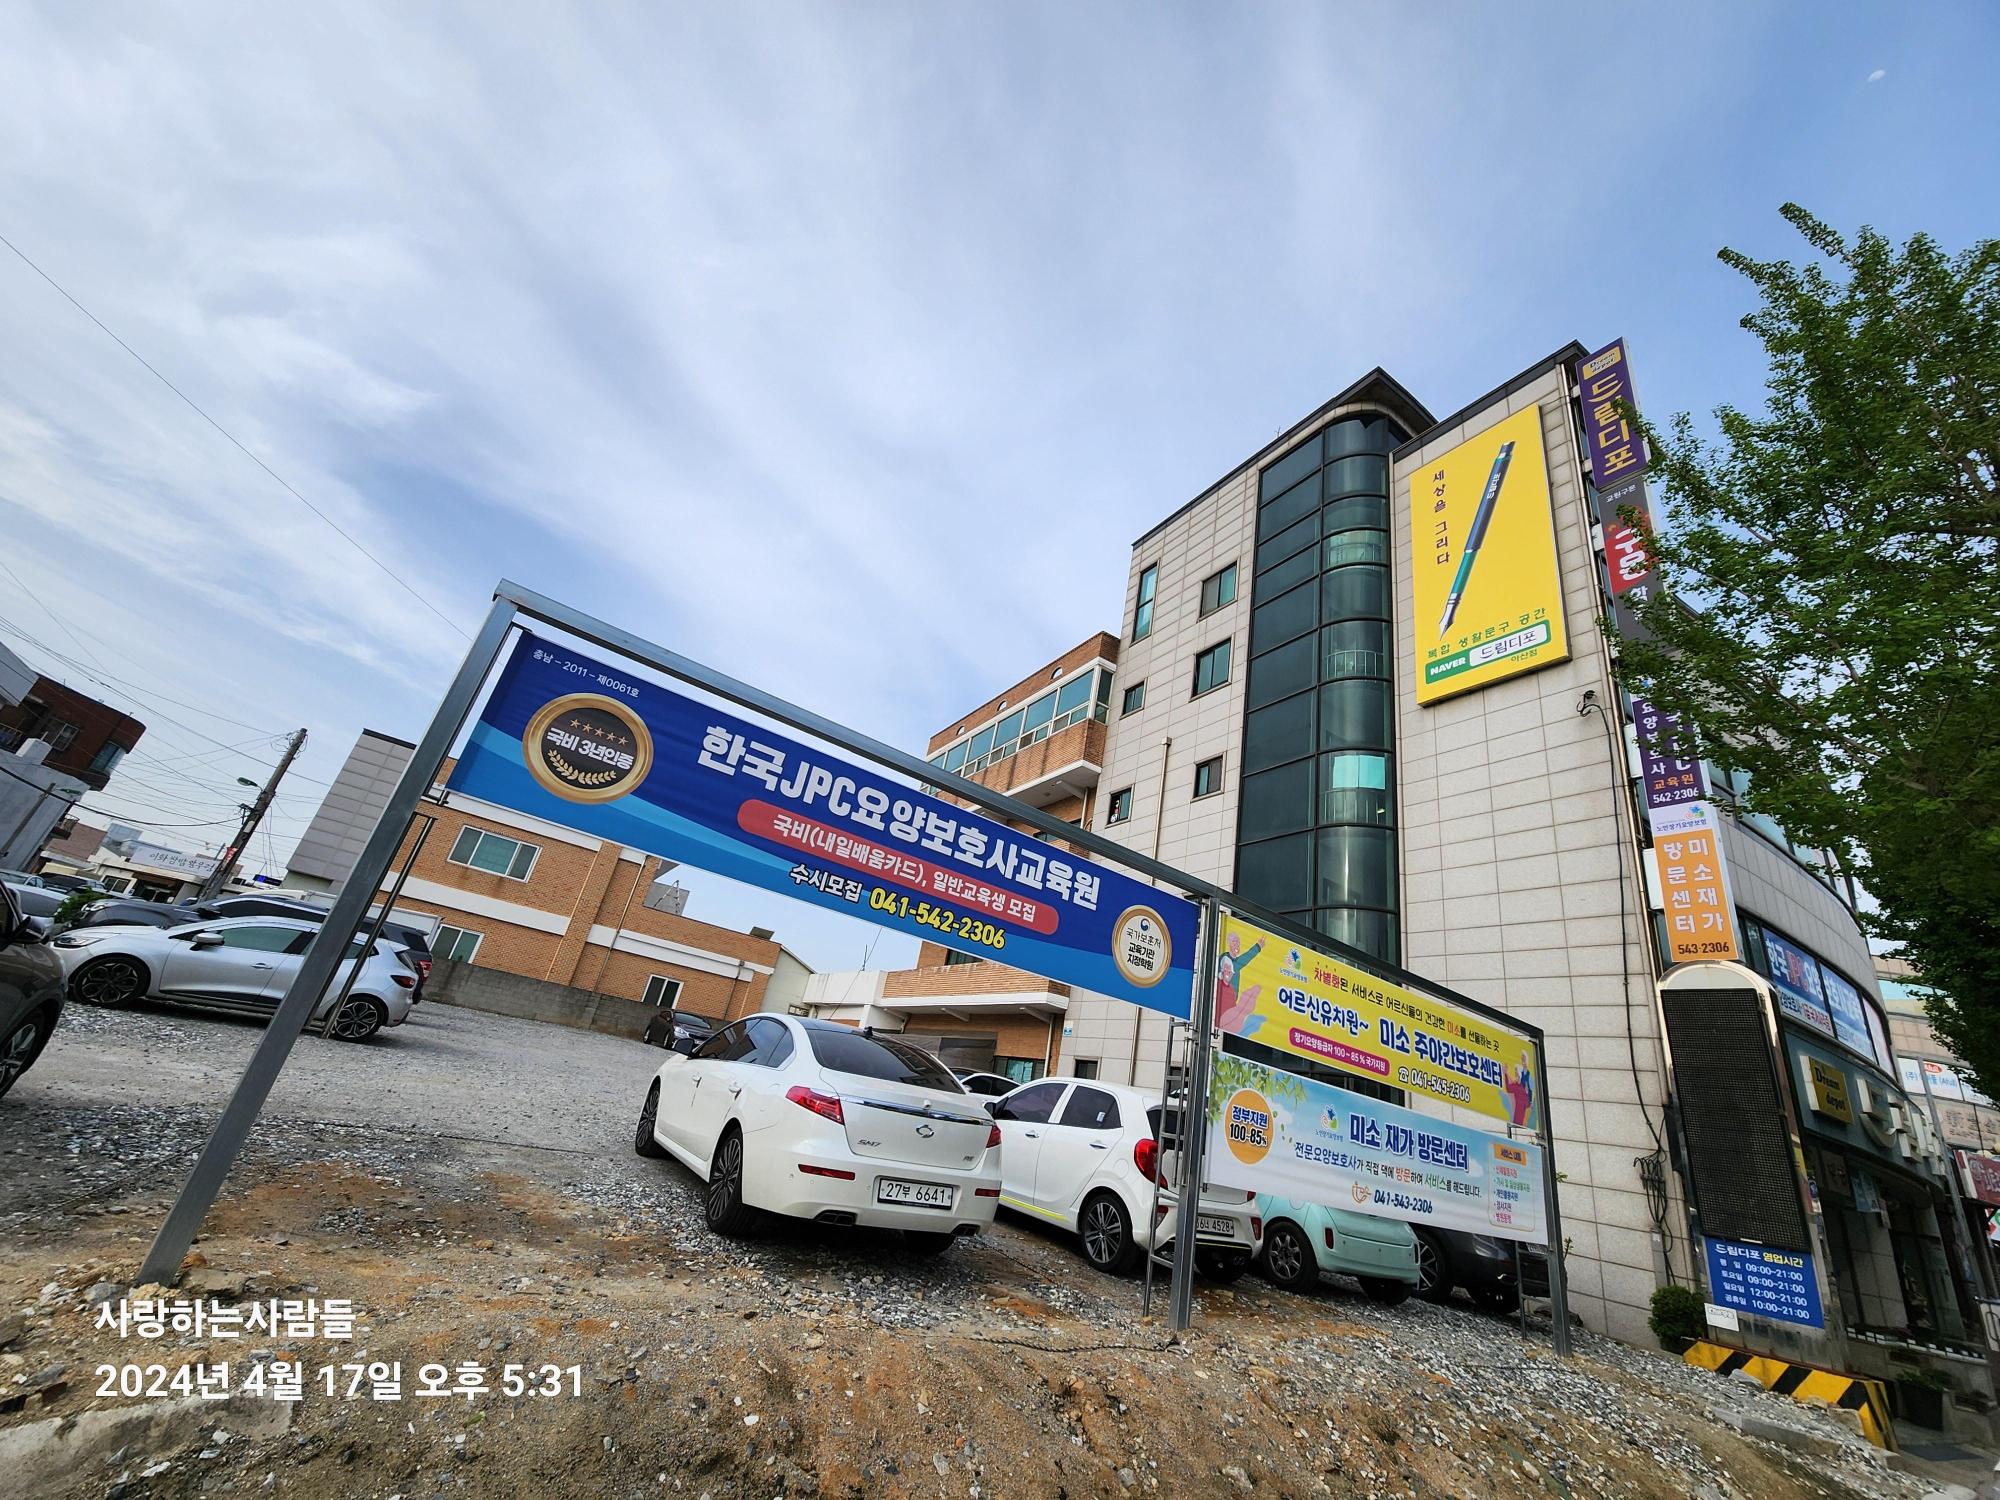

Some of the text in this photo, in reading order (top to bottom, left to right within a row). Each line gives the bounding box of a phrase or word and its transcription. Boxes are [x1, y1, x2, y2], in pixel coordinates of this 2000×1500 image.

[1435, 521, 1450, 564] 그리다
[1459, 621, 1509, 648] 생활문구
[1520, 608, 1545, 626] 공간
[1430, 630, 1536, 676] NAVER 드림디포
[1511, 649, 1538, 662] 아산점
[547, 727, 634, 770] 국비 3년인증
[1654, 773, 1695, 790] 교육원
[698, 725, 1101, 911] 한국JPC요양보호사교육원
[773, 813, 1037, 923] 국비(내일배움카드), 일반교육생 모집
[1663, 841, 1696, 934] 방문센터
[790, 863, 1006, 949] 수시모집 041-542-2306
[1126, 927, 1161, 949] 국가보훈처
[1127, 953, 1154, 971] 지정학원
[1128, 942, 1155, 960] 교육기관
[1351, 982, 1384, 1007] 서비스로
[1386, 996, 1423, 1021] 어르신들의
[1425, 1011, 1445, 1031] 건강한
[1447, 1020, 1467, 1039] 미소를
[1468, 1029, 1492, 1050] 선물하는
[1493, 1039, 1500, 1053] 곳
[1379, 1018, 1410, 1055] 미소
[1414, 1030, 1503, 1088] 주야간보호센터
[1410, 1067, 1470, 1103] 041-545-2306
[1814, 1066, 1840, 1091] Dream
[1232, 1105, 1268, 1128] 정부지원
[857, 1139, 881, 1147] SM7
[1350, 1113, 1469, 1172] 미소 재가 방문센터
[1294, 1141, 1364, 1172] 전문요양보호사가
[1365, 1161, 1379, 1176] 직접
[1380, 1164, 1394, 1180] 댁에
[1395, 1167, 1424, 1185] 방문하여
[1425, 1174, 1452, 1192] 서비스를
[886, 1183, 945, 1203] 27부 6641
[1374, 1189, 1433, 1214] 041-543-2306
[1715, 1243, 1804, 1268] 드림디포 영업시간
[1722, 1270, 1805, 1294] 토요일 09:00~21:00
[1746, 1263, 1803, 1281] 09:00~21:00
[1723, 1282, 1807, 1306] 일요일 12:00~21:00
[1725, 1294, 1747, 1306] 공휴일
[1752, 1300, 1810, 1319] 10:00~21:00
